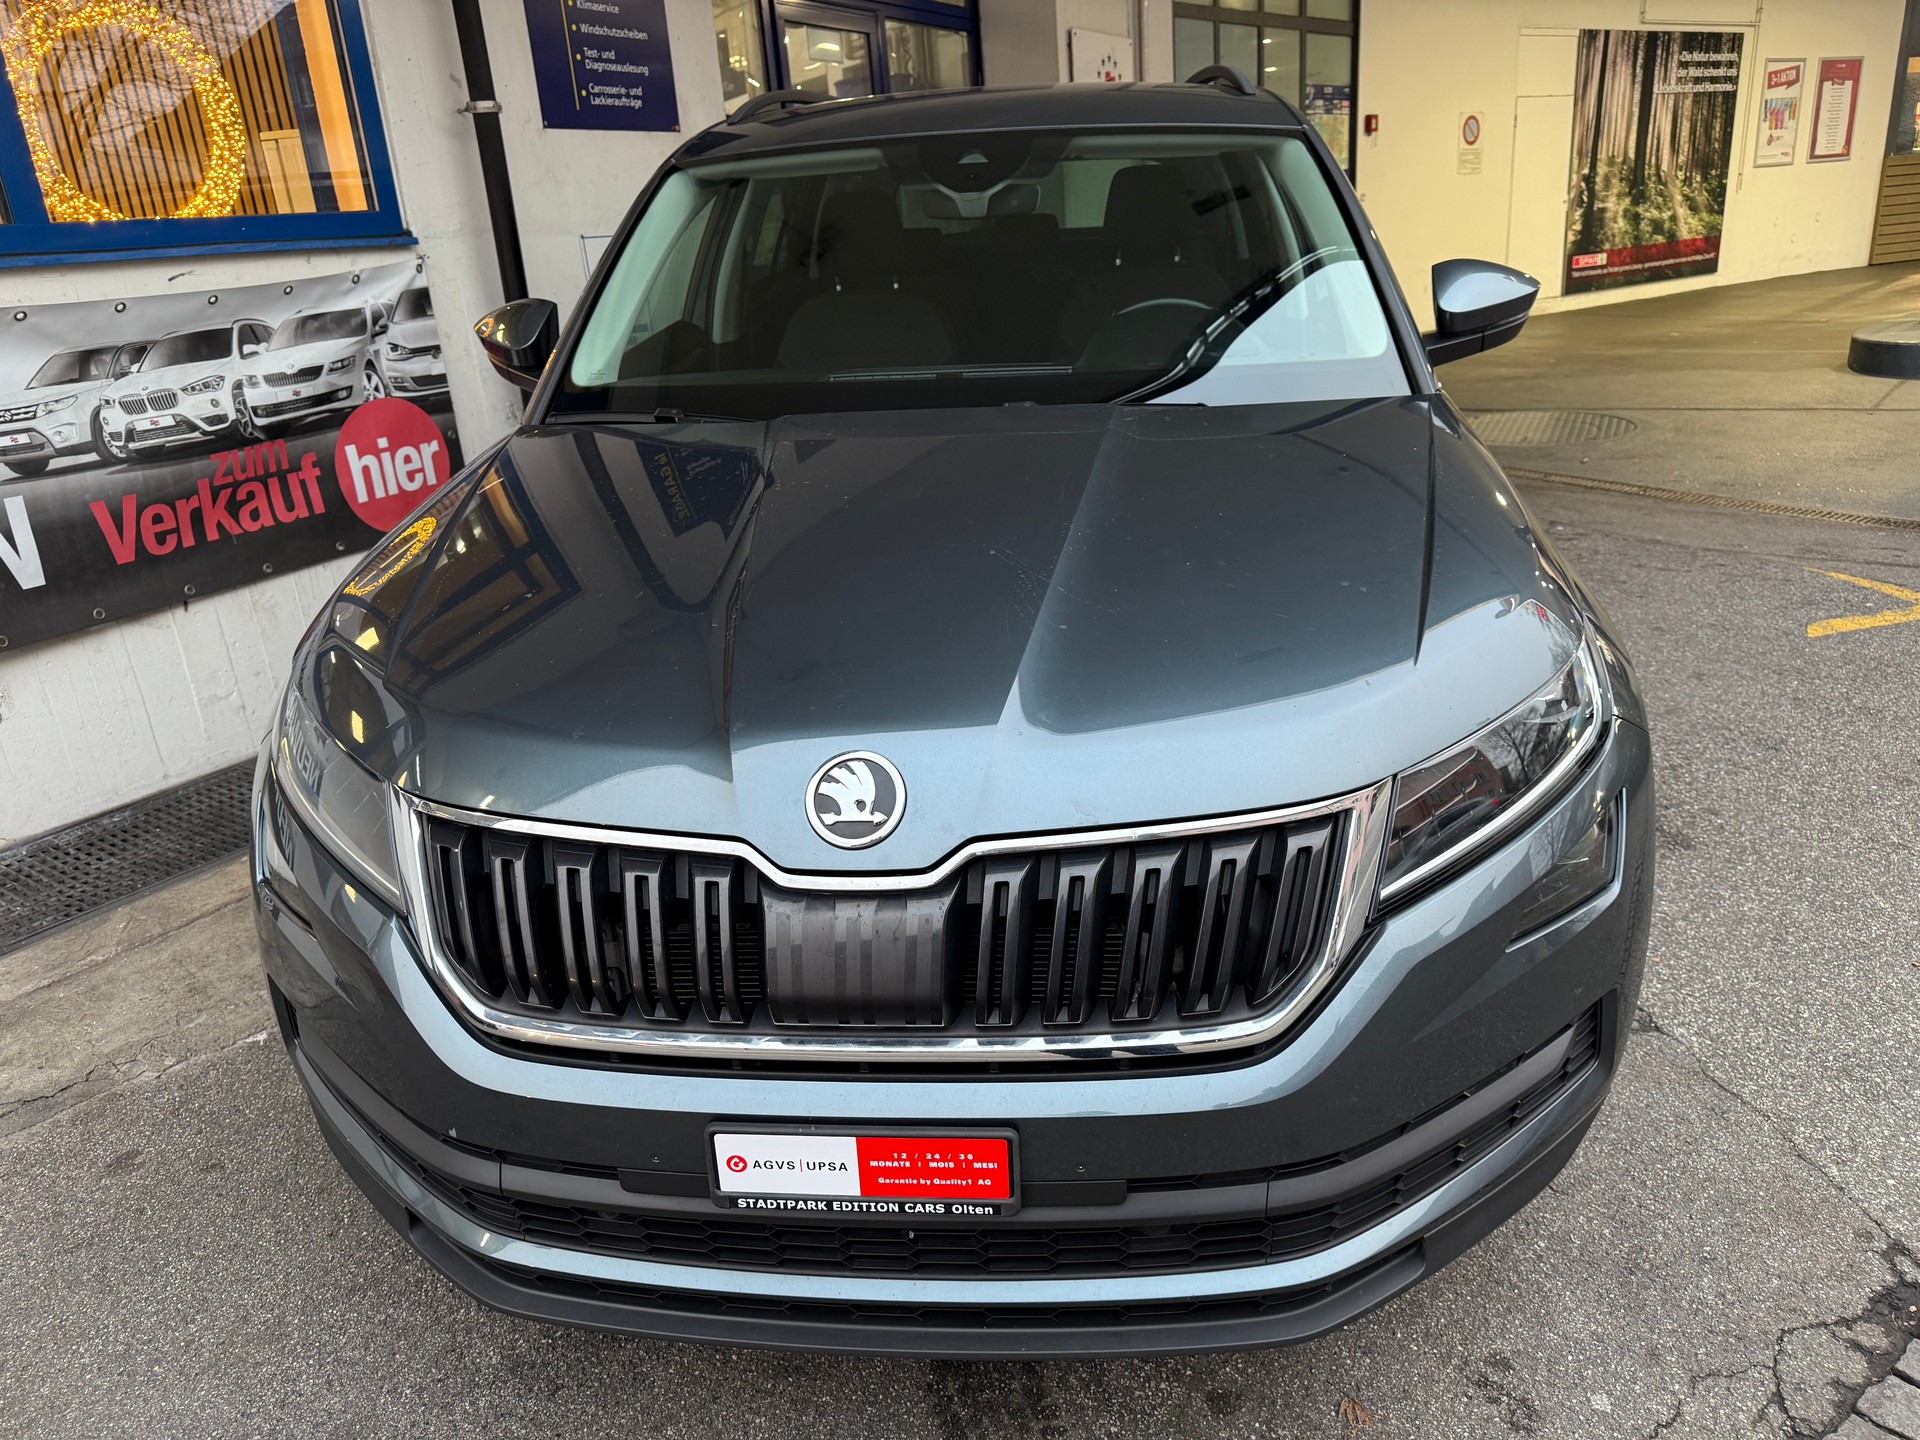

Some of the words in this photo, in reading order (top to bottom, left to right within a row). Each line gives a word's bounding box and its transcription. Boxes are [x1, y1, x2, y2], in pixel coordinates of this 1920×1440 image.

[576, 0, 620, 14] Klimaservice
[579, 23, 648, 40] Windschutzscheiben
[583, 47, 600, 59] Test-
[601, 50, 616, 60] und
[1693, 50, 1709, 62] Natur
[585, 59, 649, 77] Diagnoseauslesung
[1677, 67, 1688, 78] der
[1688, 66, 1703, 77] Wald
[1726, 68, 1738, 77] uns
[588, 82, 628, 96] Carrosserie-
[629, 86, 643, 96] und
[590, 95, 643, 110] Lackieraufträge
[210, 438, 289, 487] zum
[344, 436, 440, 503] hier
[89, 452, 327, 566] Verkauf
[752, 1160, 796, 1171] AGVS
[806, 1161, 848, 1172] UPSA
[878, 1177, 918, 1185] Garantie
[919, 1178, 931, 1186] by
[737, 1198, 828, 1211] STADTPARK
[832, 1201, 899, 1213] EDITION
[904, 1202, 945, 1214] CARS
[951, 1203, 994, 1215] Olten
